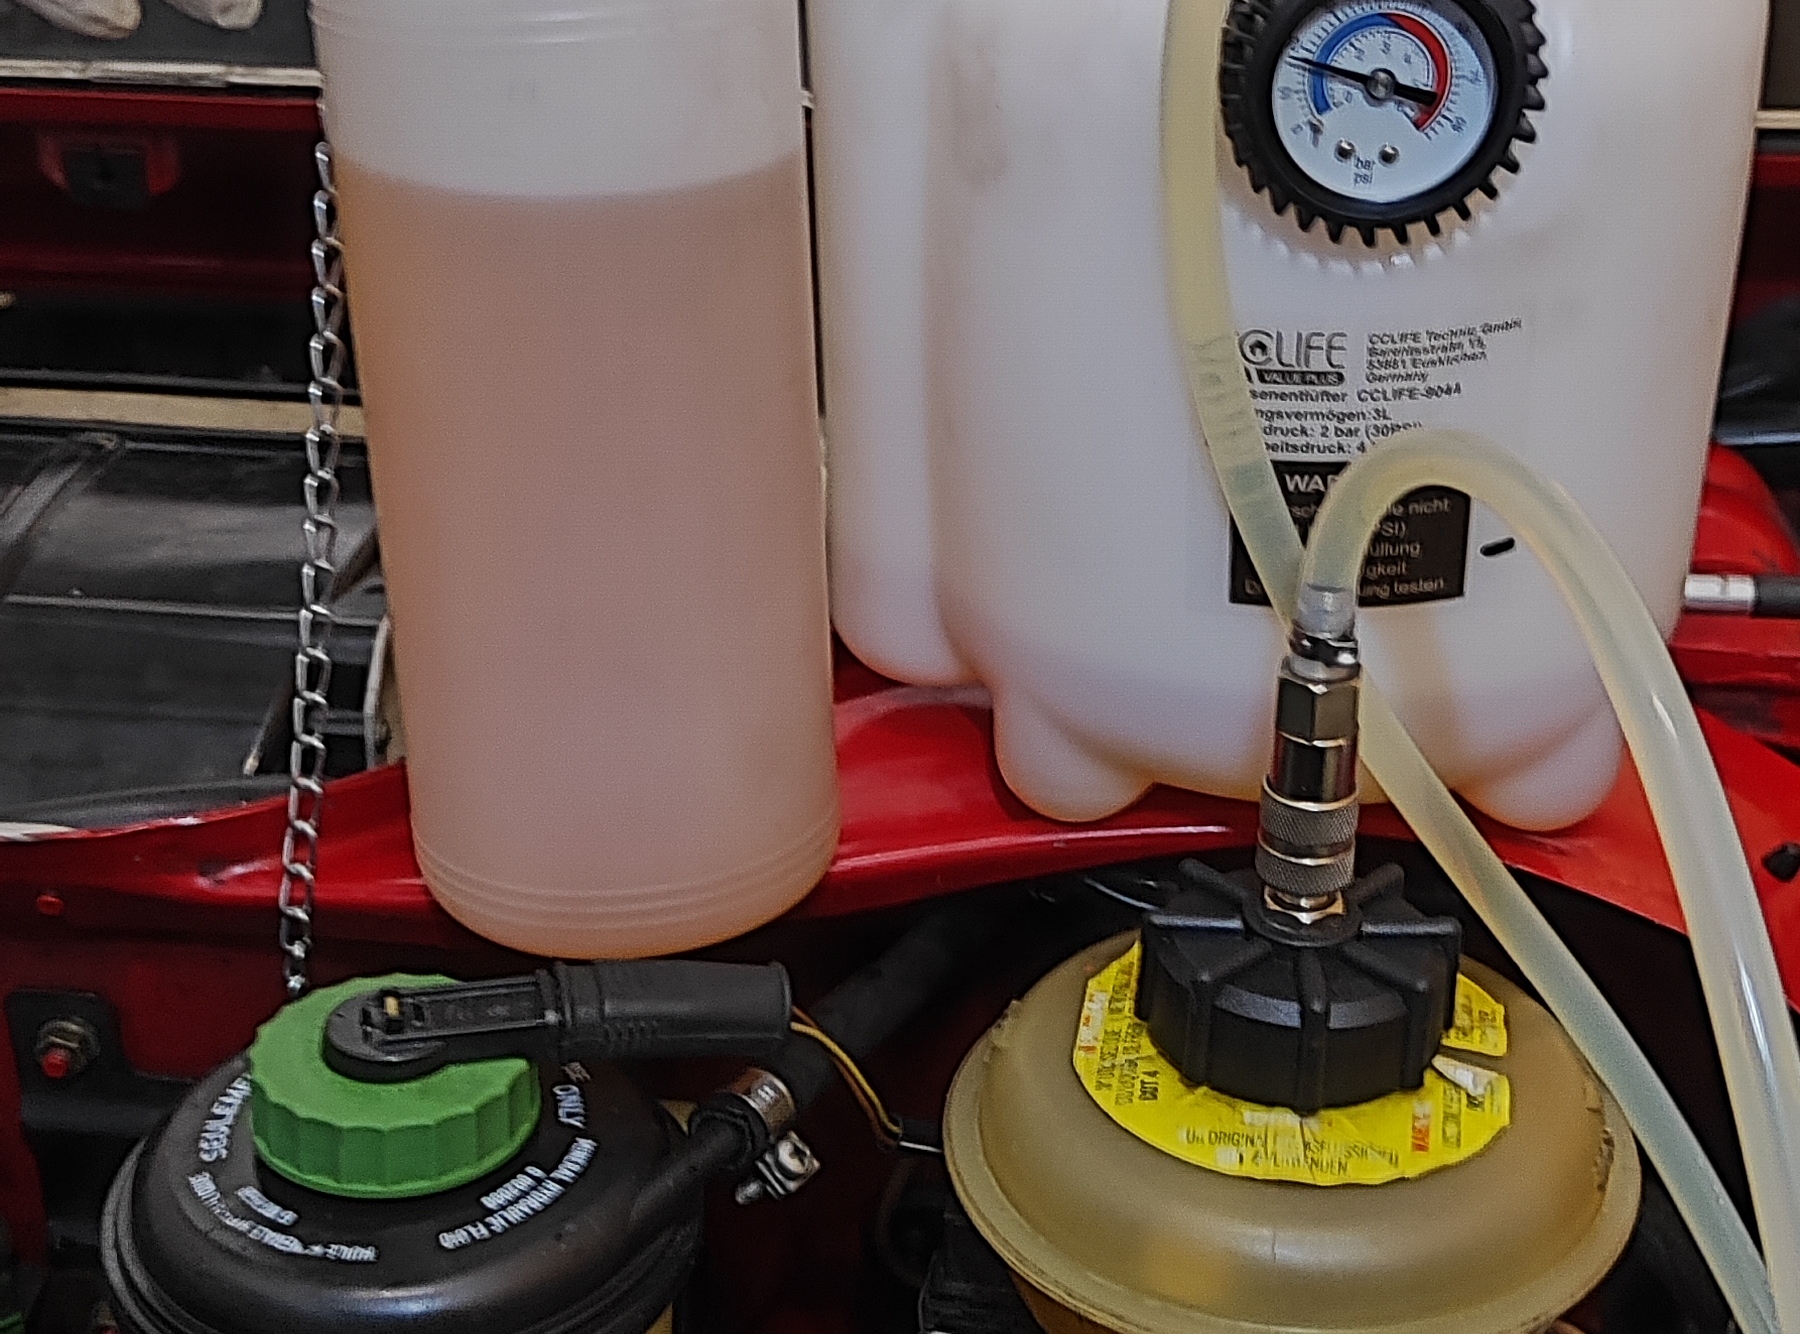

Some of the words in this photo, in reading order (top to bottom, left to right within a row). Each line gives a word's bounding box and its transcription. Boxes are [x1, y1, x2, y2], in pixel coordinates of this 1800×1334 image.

[1354, 173, 1373, 187] psi
[1236, 328, 1348, 369] CLIFE
[1263, 424, 1316, 438] druck:
[1334, 425, 1361, 438] bar
[1408, 497, 1451, 516] nicht
[1394, 577, 1445, 595] testen
[552, 1084, 588, 1131] ONLY
